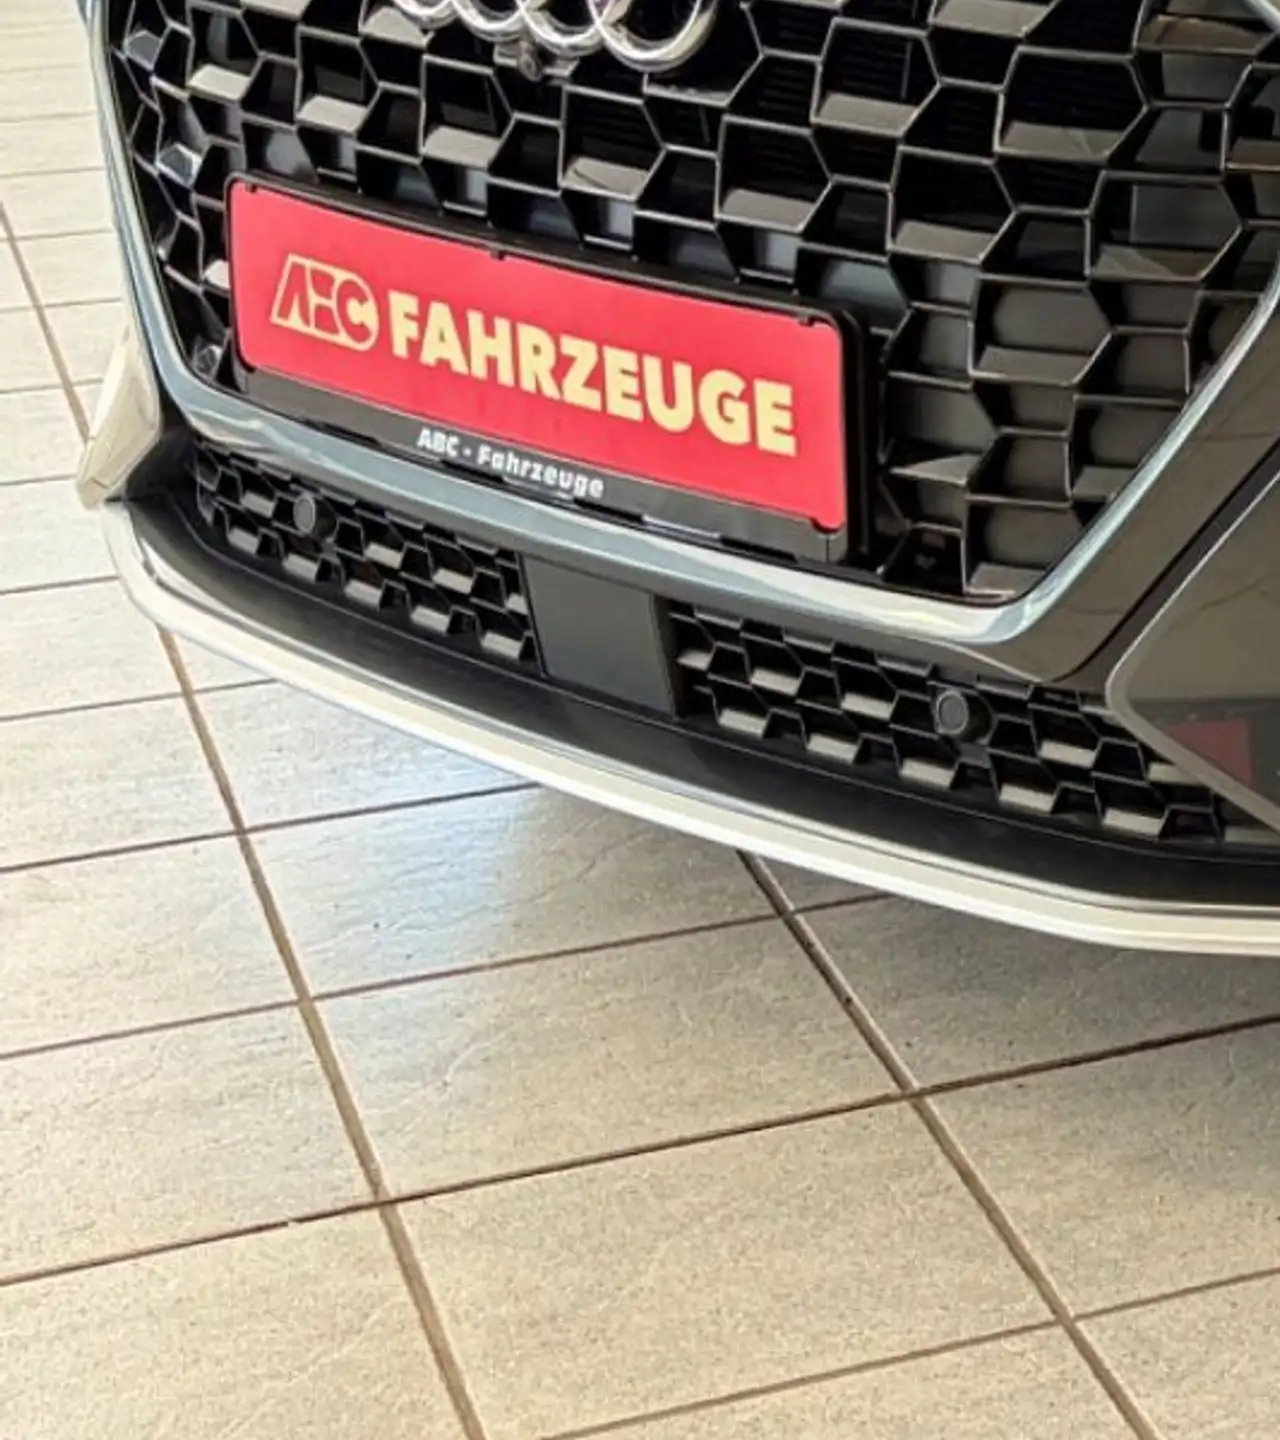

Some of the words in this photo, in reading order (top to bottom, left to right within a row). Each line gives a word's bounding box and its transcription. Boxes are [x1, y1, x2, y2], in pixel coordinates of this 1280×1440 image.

[387, 290, 798, 457] FAHRZEUGE
[416, 426, 461, 458] ABC
[476, 443, 605, 499] Fahrzeuge
